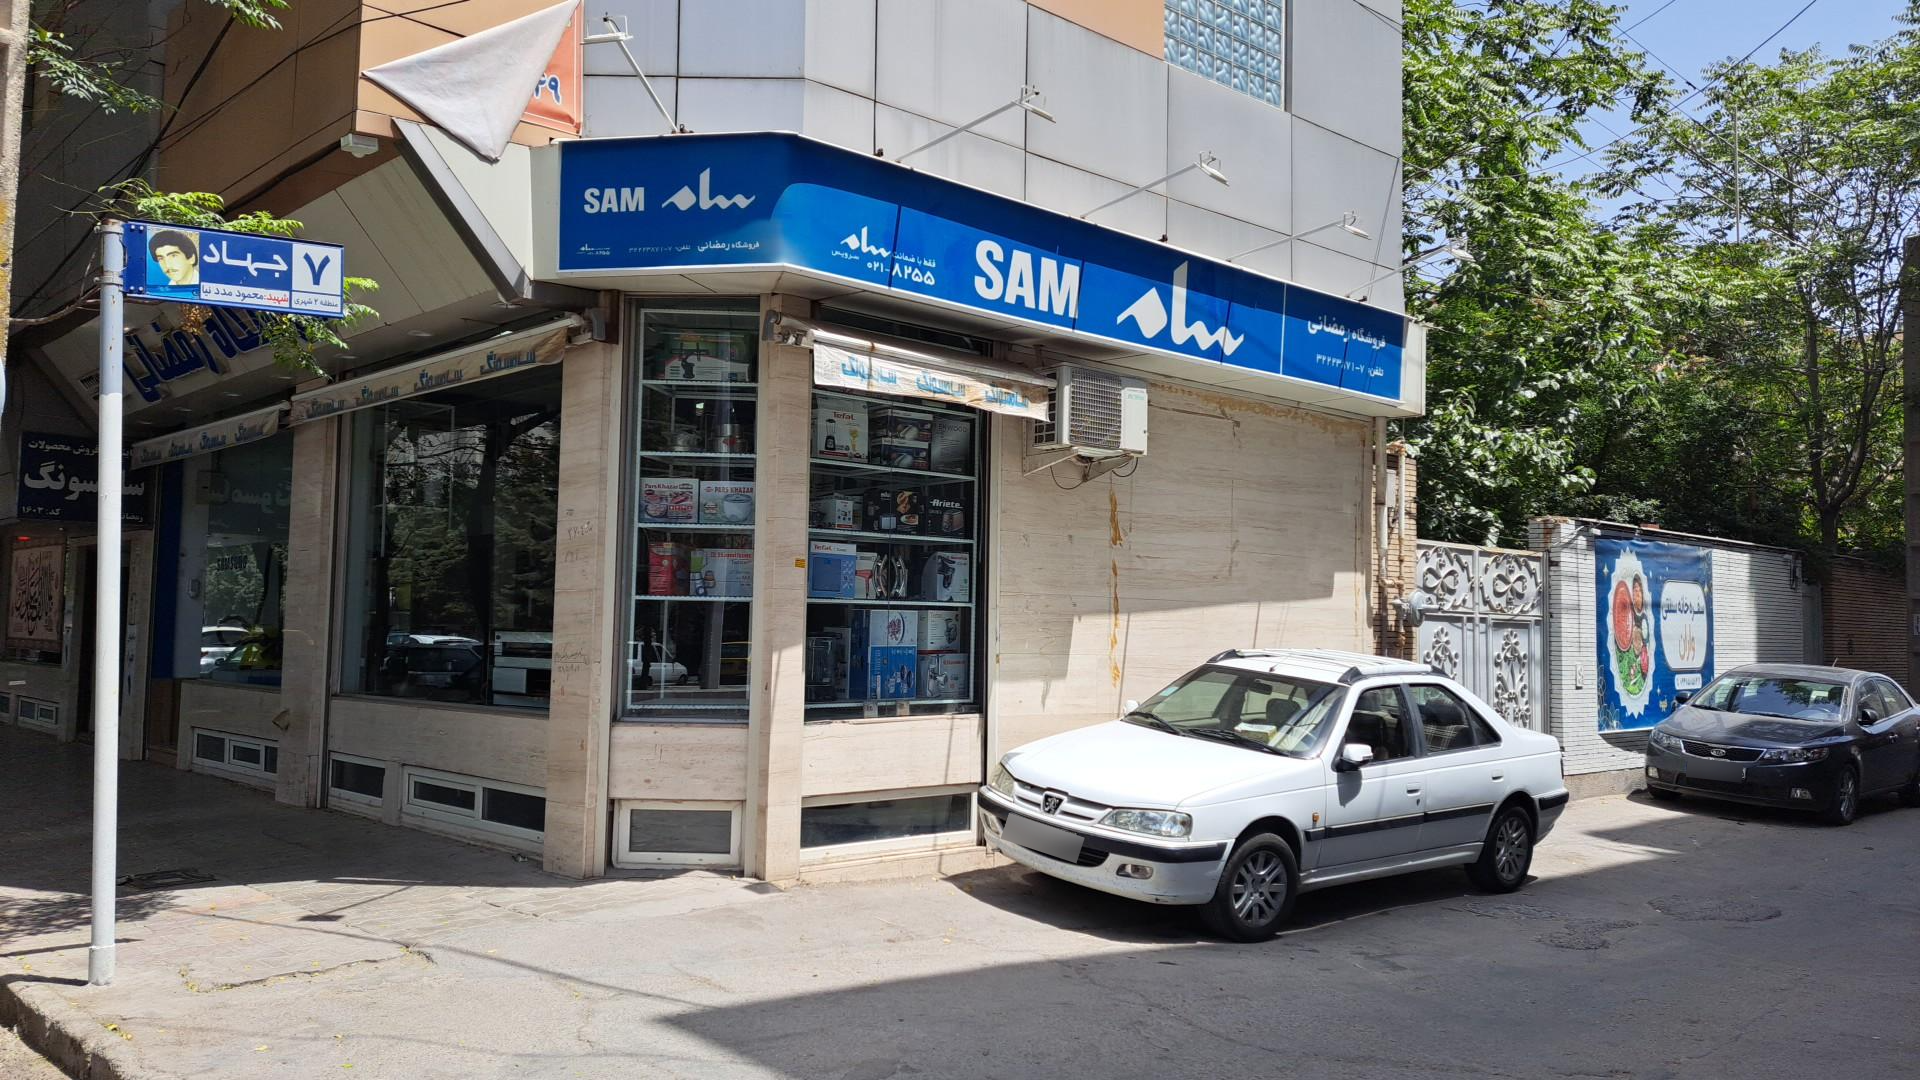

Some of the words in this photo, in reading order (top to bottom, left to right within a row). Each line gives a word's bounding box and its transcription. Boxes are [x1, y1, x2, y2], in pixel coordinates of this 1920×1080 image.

[661, 167, 756, 211] سام
[584, 187, 645, 213] SAM
[696, 240, 730, 253] رمضانی
[730, 240, 760, 251] فروشگاه
[840, 225, 891, 258] سام
[203, 240, 289, 278] جهاد
[832, 249, 859, 260] سرویس
[915, 256, 923, 266] با
[923, 258, 936, 268] فقط
[303, 252, 331, 286] ۷
[974, 240, 1080, 319] SAM
[201, 285, 212, 296] نیا
[214, 288, 233, 297] مدد
[235, 289, 264, 301] محمود
[294, 297, 313, 307] شهری
[319, 299, 339, 308] منطقه
[1116, 261, 1245, 356] سام
[1307, 314, 1350, 343] رمضانی
[1351, 328, 1386, 350] فروشگاه
[938, 423, 967, 432] ENWOOD
[28, 440, 72, 452] محصولات
[24, 461, 145, 501] ساسونگ
[929, 498, 963, 508] Ariete
